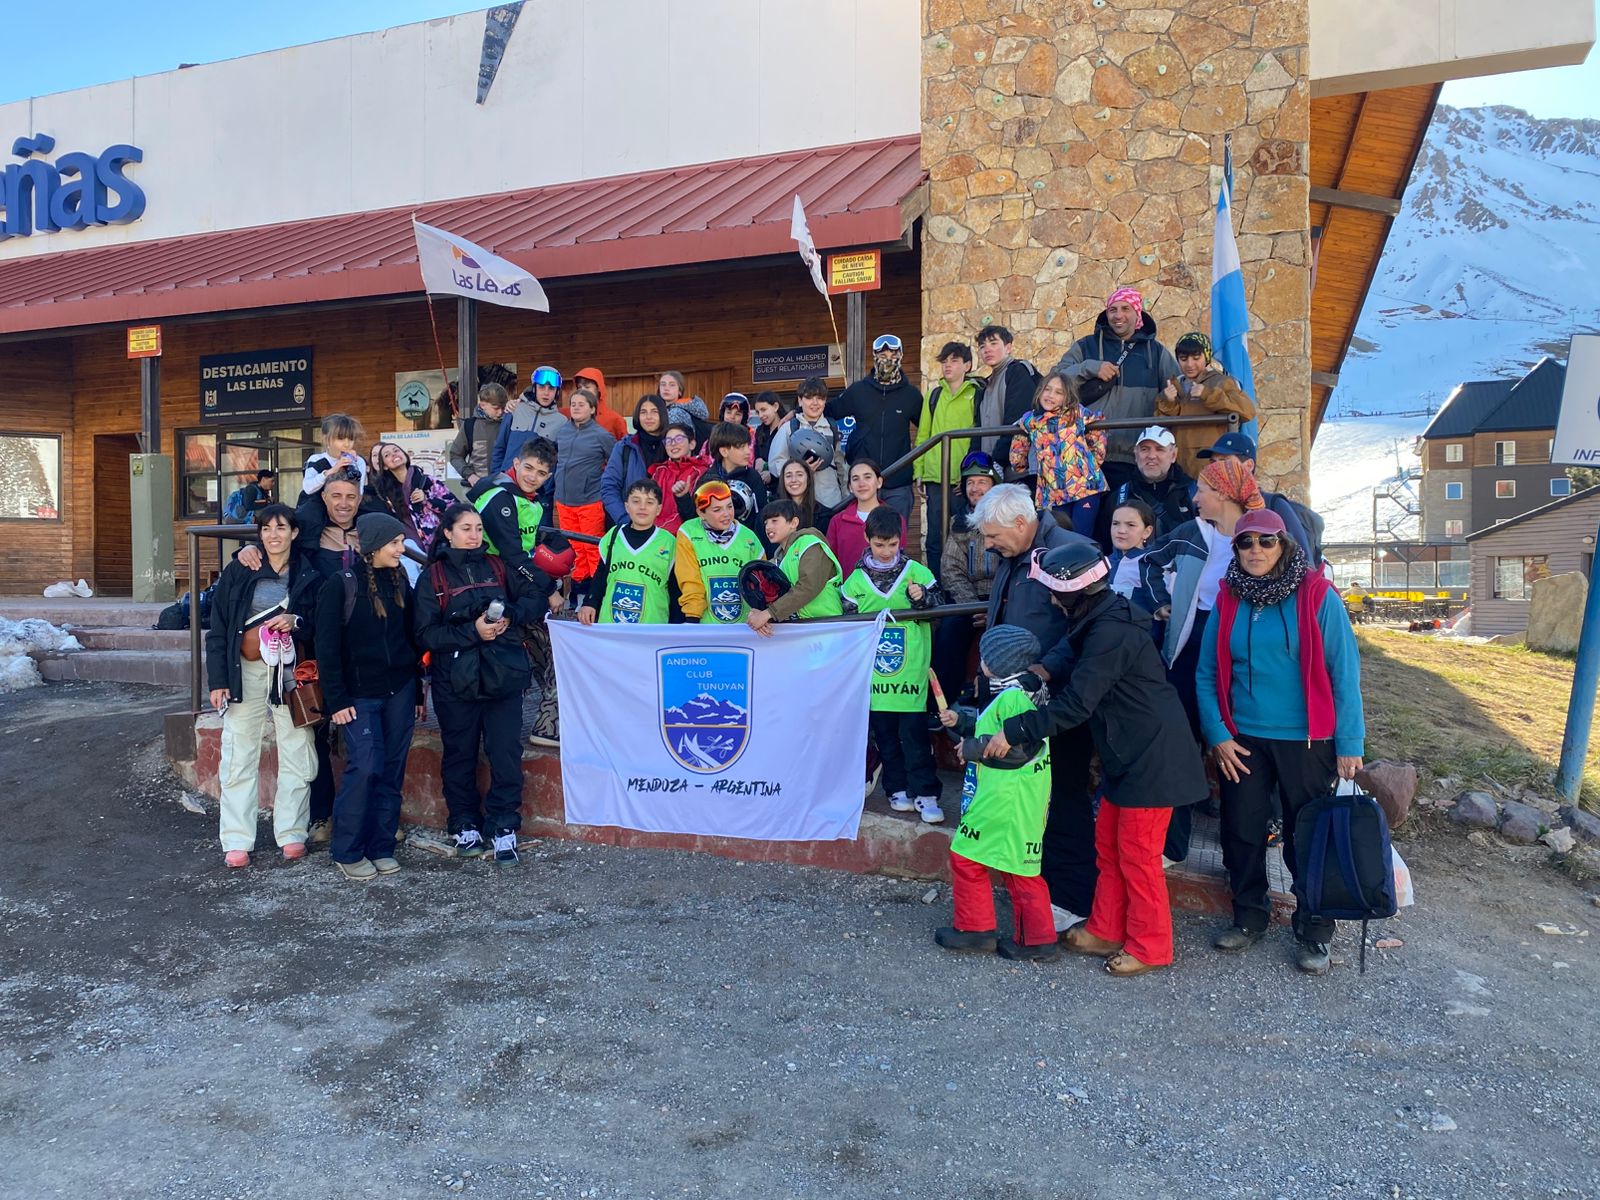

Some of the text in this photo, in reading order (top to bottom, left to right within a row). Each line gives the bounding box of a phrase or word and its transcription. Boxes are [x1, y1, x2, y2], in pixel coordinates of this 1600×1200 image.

[452, 268, 474, 290] Las
[755, 356, 785, 365] SERVICIO
[796, 353, 827, 362] HUESPED
[203, 359, 307, 379] DESTACAMENTO
[756, 366, 777, 374] GUEST
[779, 362, 825, 372] RELATIONSHIP
[227, 377, 284, 392] LAS LEÑAS
[609, 561, 635, 574] DINO
[699, 555, 744, 568] DINO CL
[713, 581, 739, 589] A.C.T.
[616, 587, 641, 597] A.C.T.
[666, 657, 708, 666] ANDINO
[686, 670, 713, 679] CLUB
[697, 682, 745, 691] TUNUYAN
[872, 681, 919, 695] NUYÁN
[627, 777, 688, 793] MENDOZA
[711, 779, 782, 797] ARGENTINA
[1026, 842, 1041, 855] TU
